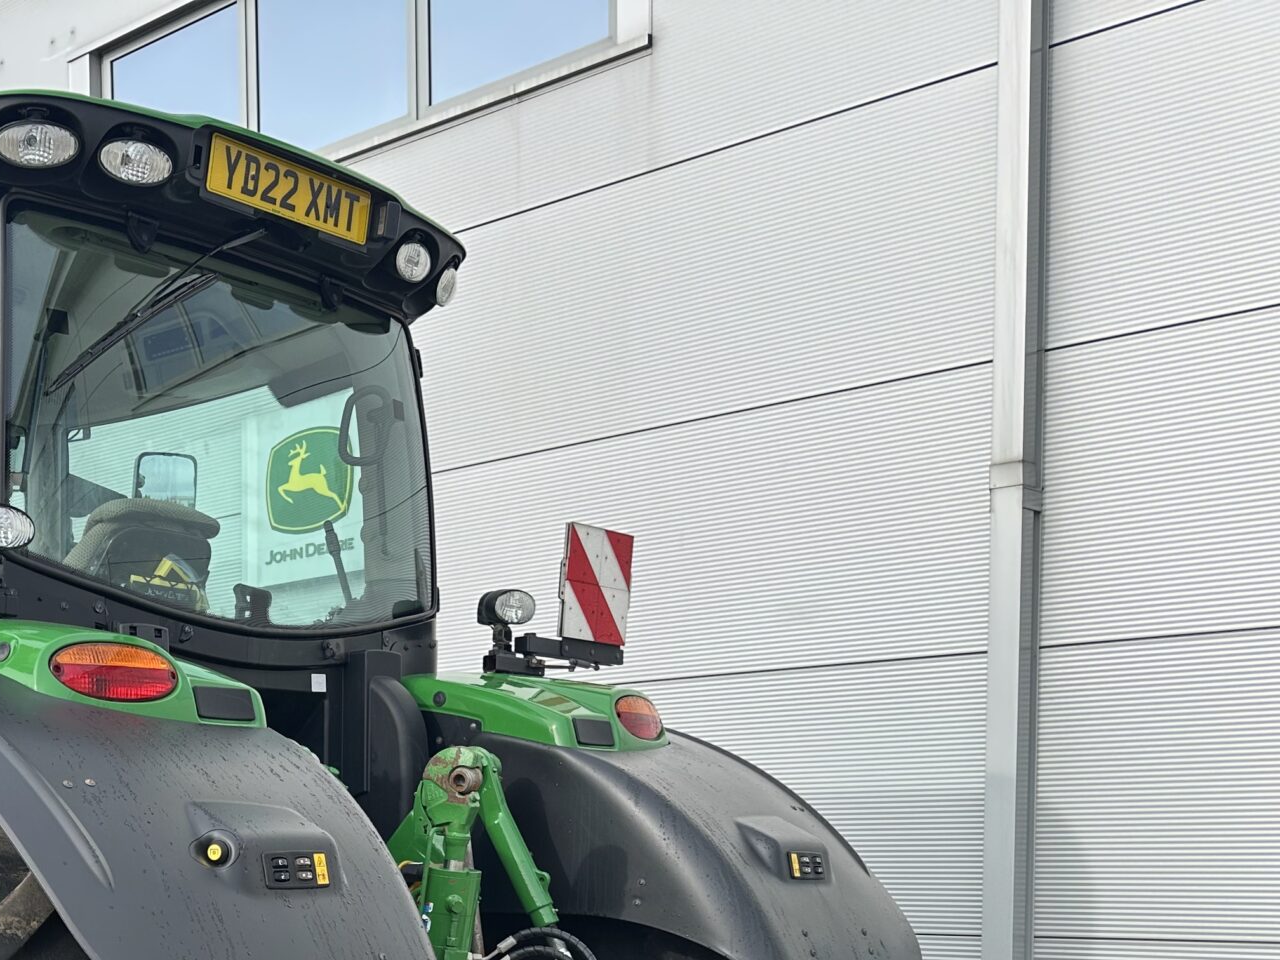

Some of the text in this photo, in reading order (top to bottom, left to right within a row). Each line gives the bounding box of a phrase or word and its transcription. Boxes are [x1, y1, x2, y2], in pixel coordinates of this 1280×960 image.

[225, 145, 360, 232] YB22 XMT
[265, 547, 304, 565] JOHN
